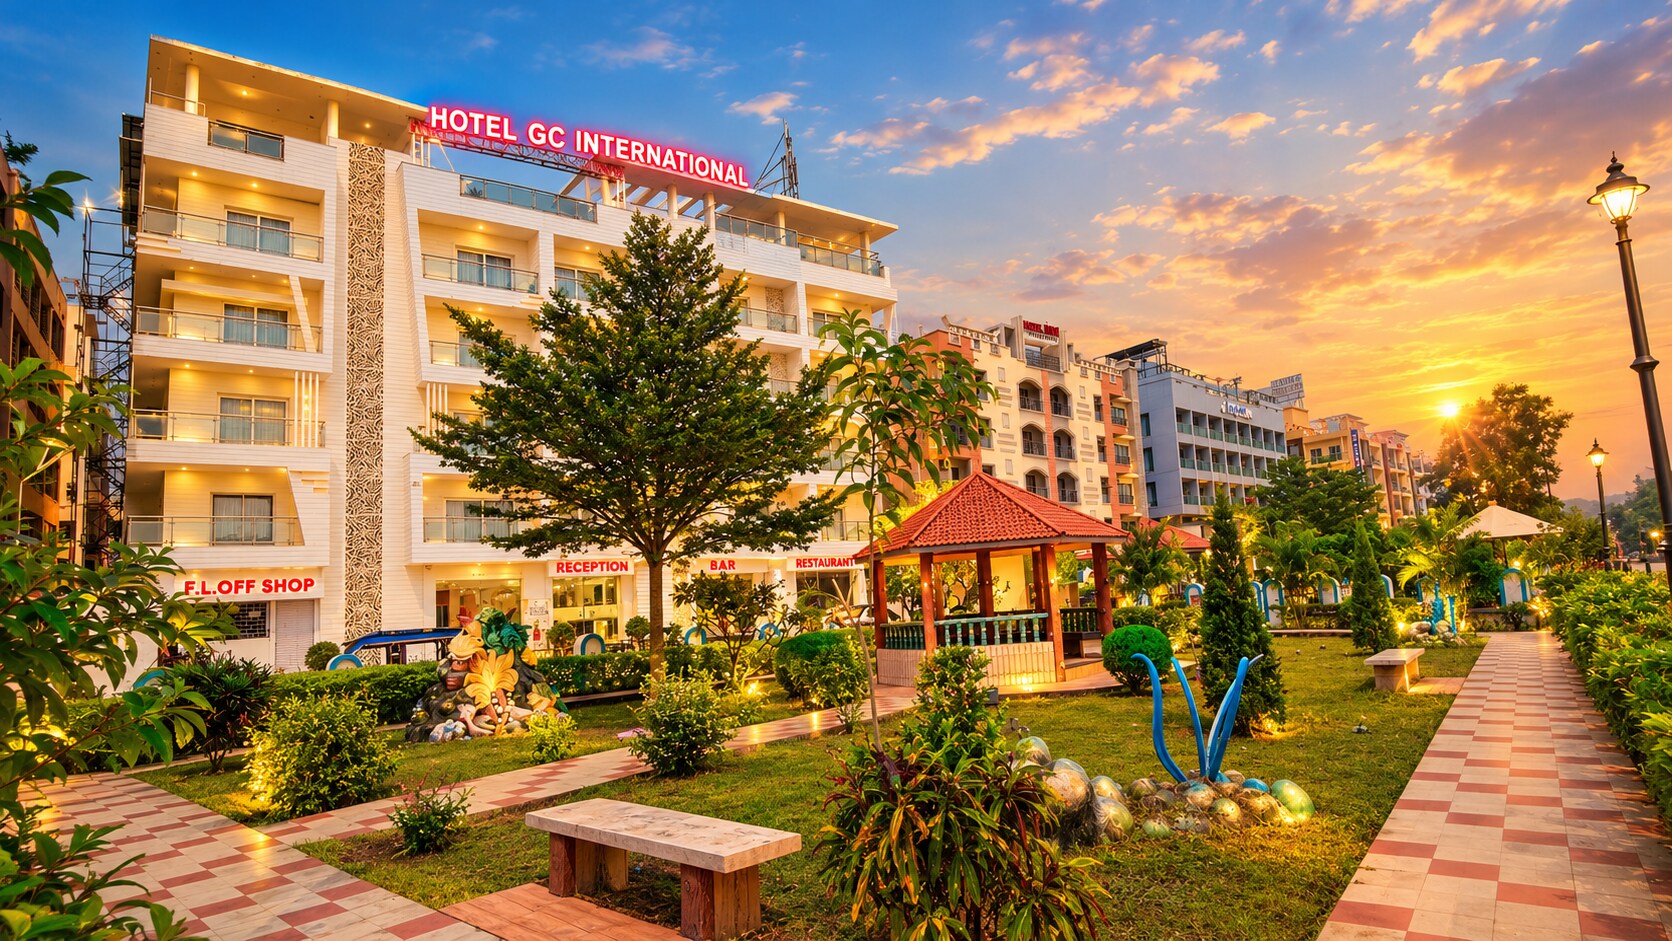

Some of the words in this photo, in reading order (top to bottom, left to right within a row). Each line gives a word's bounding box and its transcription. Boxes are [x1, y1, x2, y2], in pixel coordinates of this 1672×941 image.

[430, 105, 518, 142] HOTEL
[528, 122, 566, 149] GC
[576, 129, 750, 188] INTERNATIONAL
[556, 560, 629, 574] RECEPTION
[709, 559, 736, 571] BAR
[795, 557, 856, 569] RESTAURANT
[184, 578, 256, 596] F.L.OFF
[261, 577, 316, 594] SHOP
